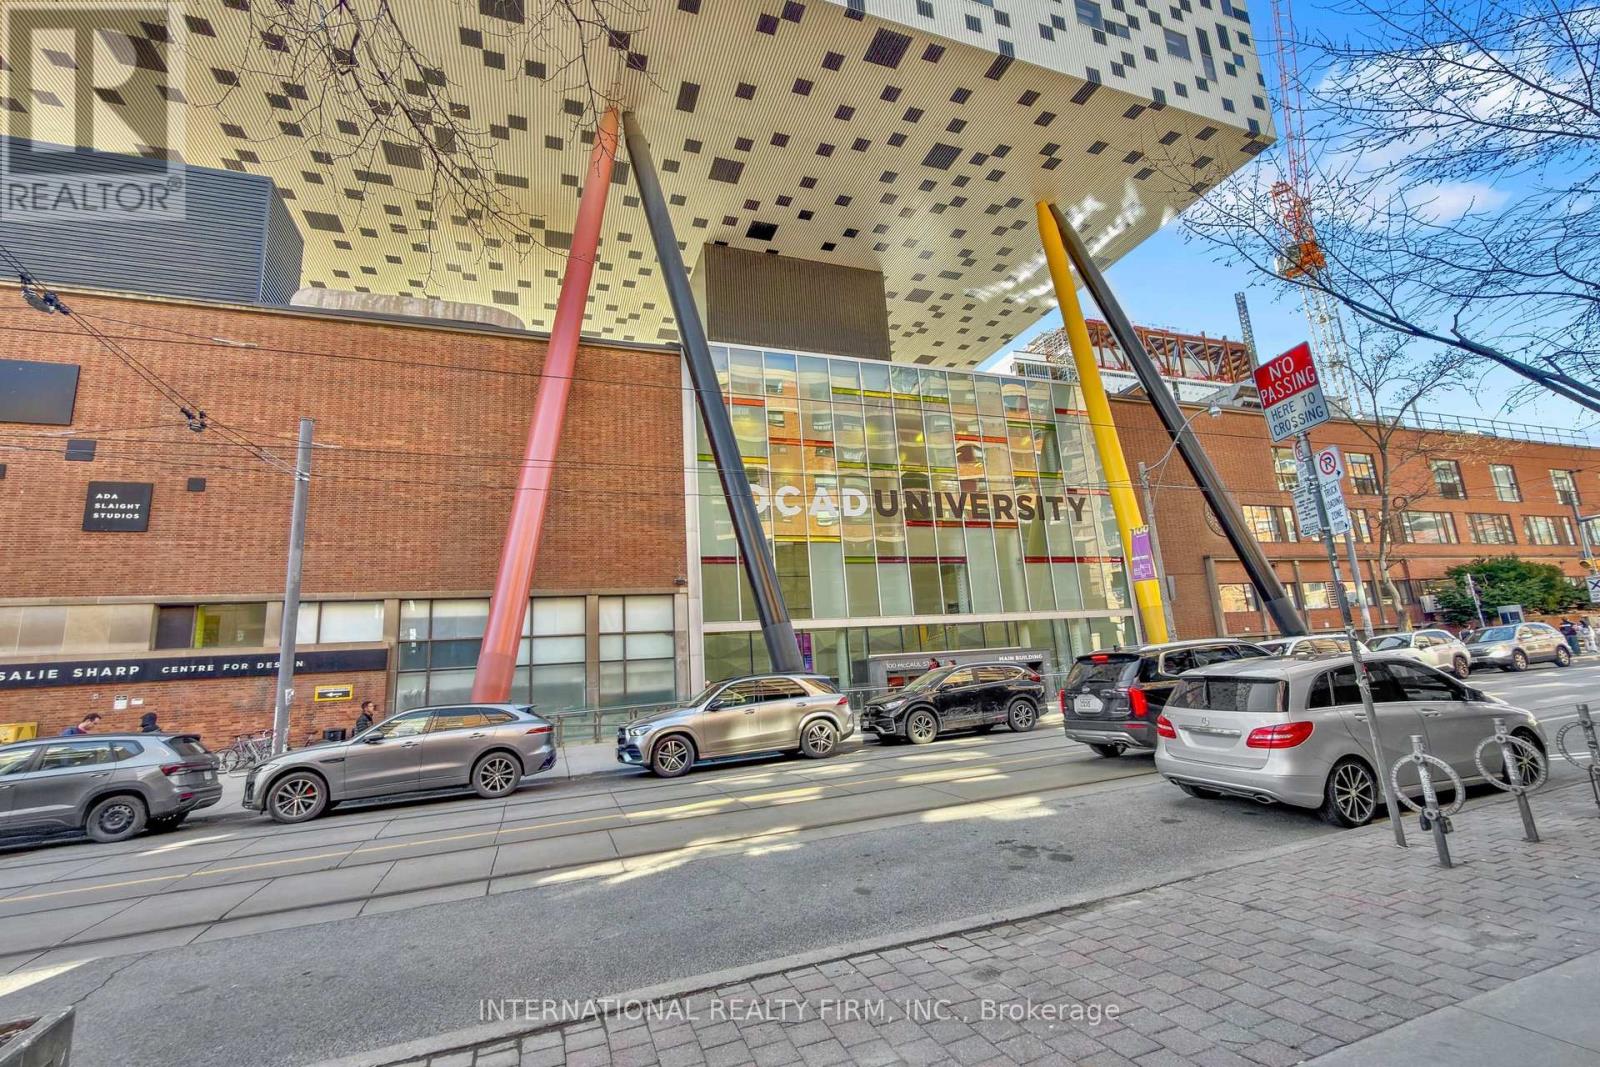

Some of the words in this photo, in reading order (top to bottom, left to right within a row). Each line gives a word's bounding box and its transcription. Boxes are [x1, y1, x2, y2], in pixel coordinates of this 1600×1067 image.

[1268, 356, 1294, 382] NO
[1260, 365, 1315, 406] PASSING
[1270, 400, 1297, 422] HERE
[1301, 391, 1316, 407] TO
[1273, 405, 1324, 436] CROSSING
[874, 489, 1086, 522] UNIVERSITY
[72, 666, 140, 678] SHARP
[162, 664, 215, 673] CENTRE
[257, 661, 304, 669] DESN
